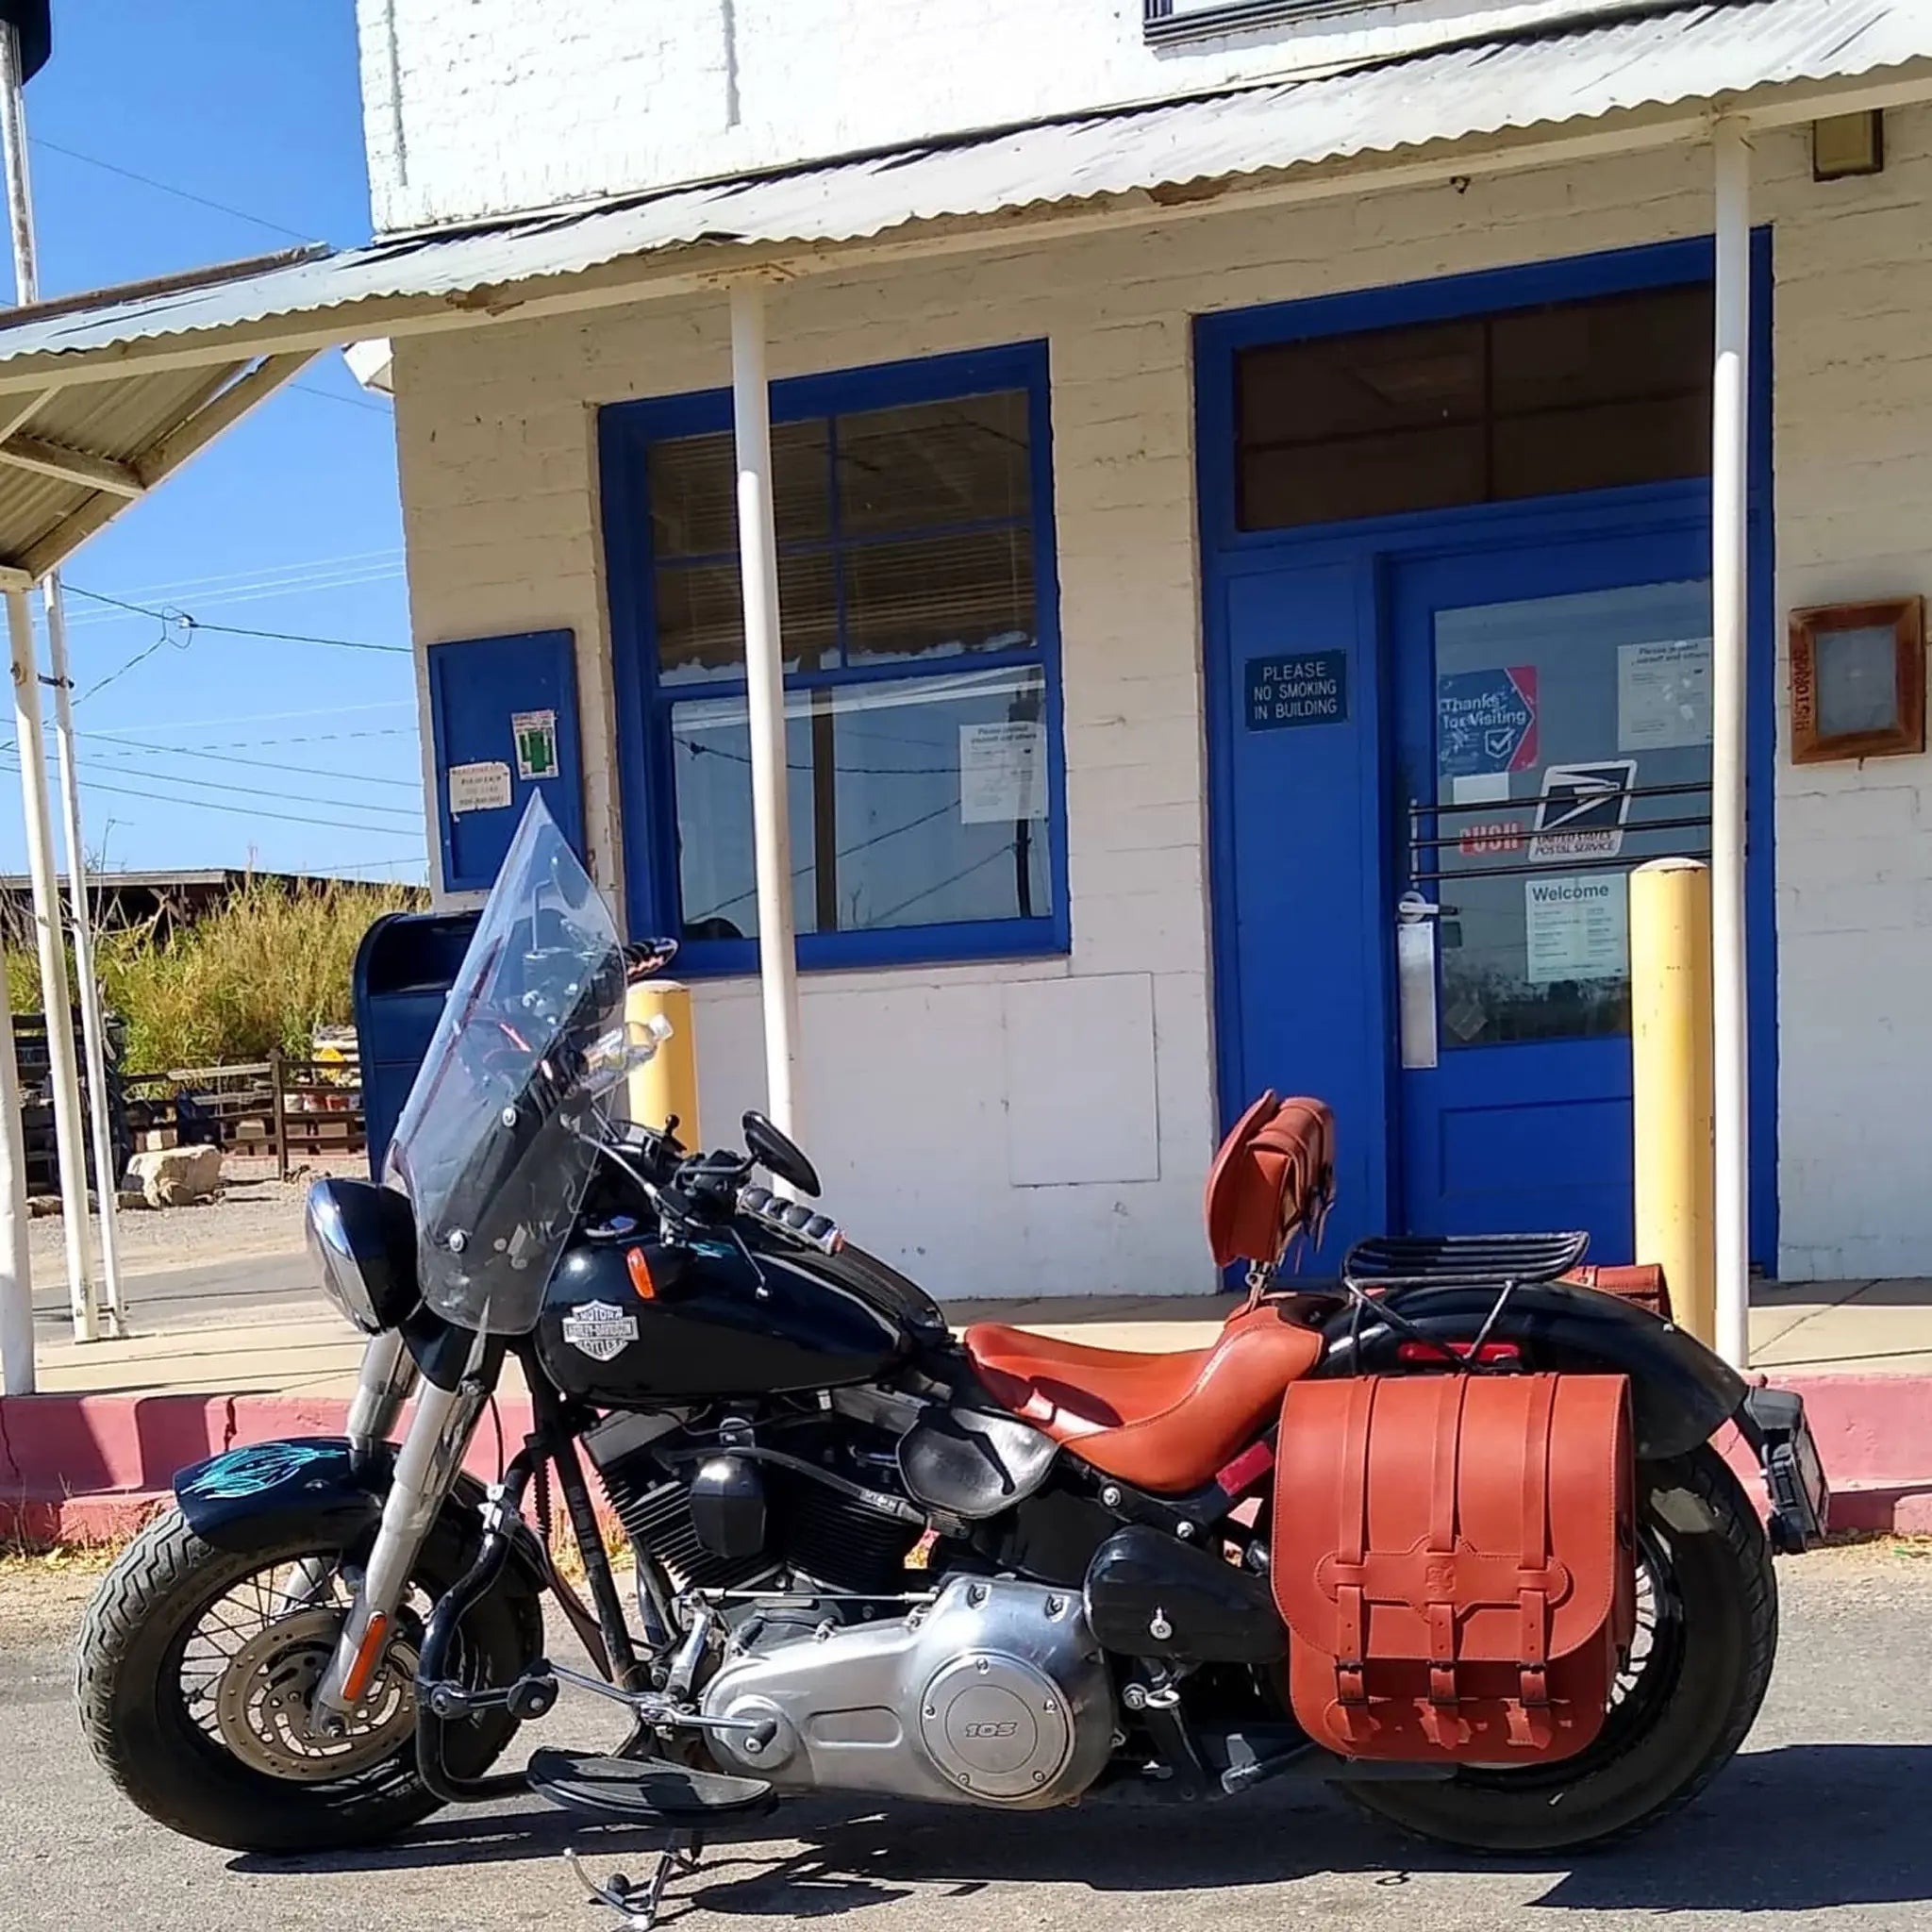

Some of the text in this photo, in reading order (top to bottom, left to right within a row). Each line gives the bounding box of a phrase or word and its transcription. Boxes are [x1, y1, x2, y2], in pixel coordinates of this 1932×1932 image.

[1262, 660, 1327, 682] PLEASE
[1254, 678, 1338, 702] NO SMOKING
[1254, 698, 1339, 721] IN BUILDING
[1467, 710, 1526, 726] Visiting
[1532, 884, 1609, 902] Welcome
